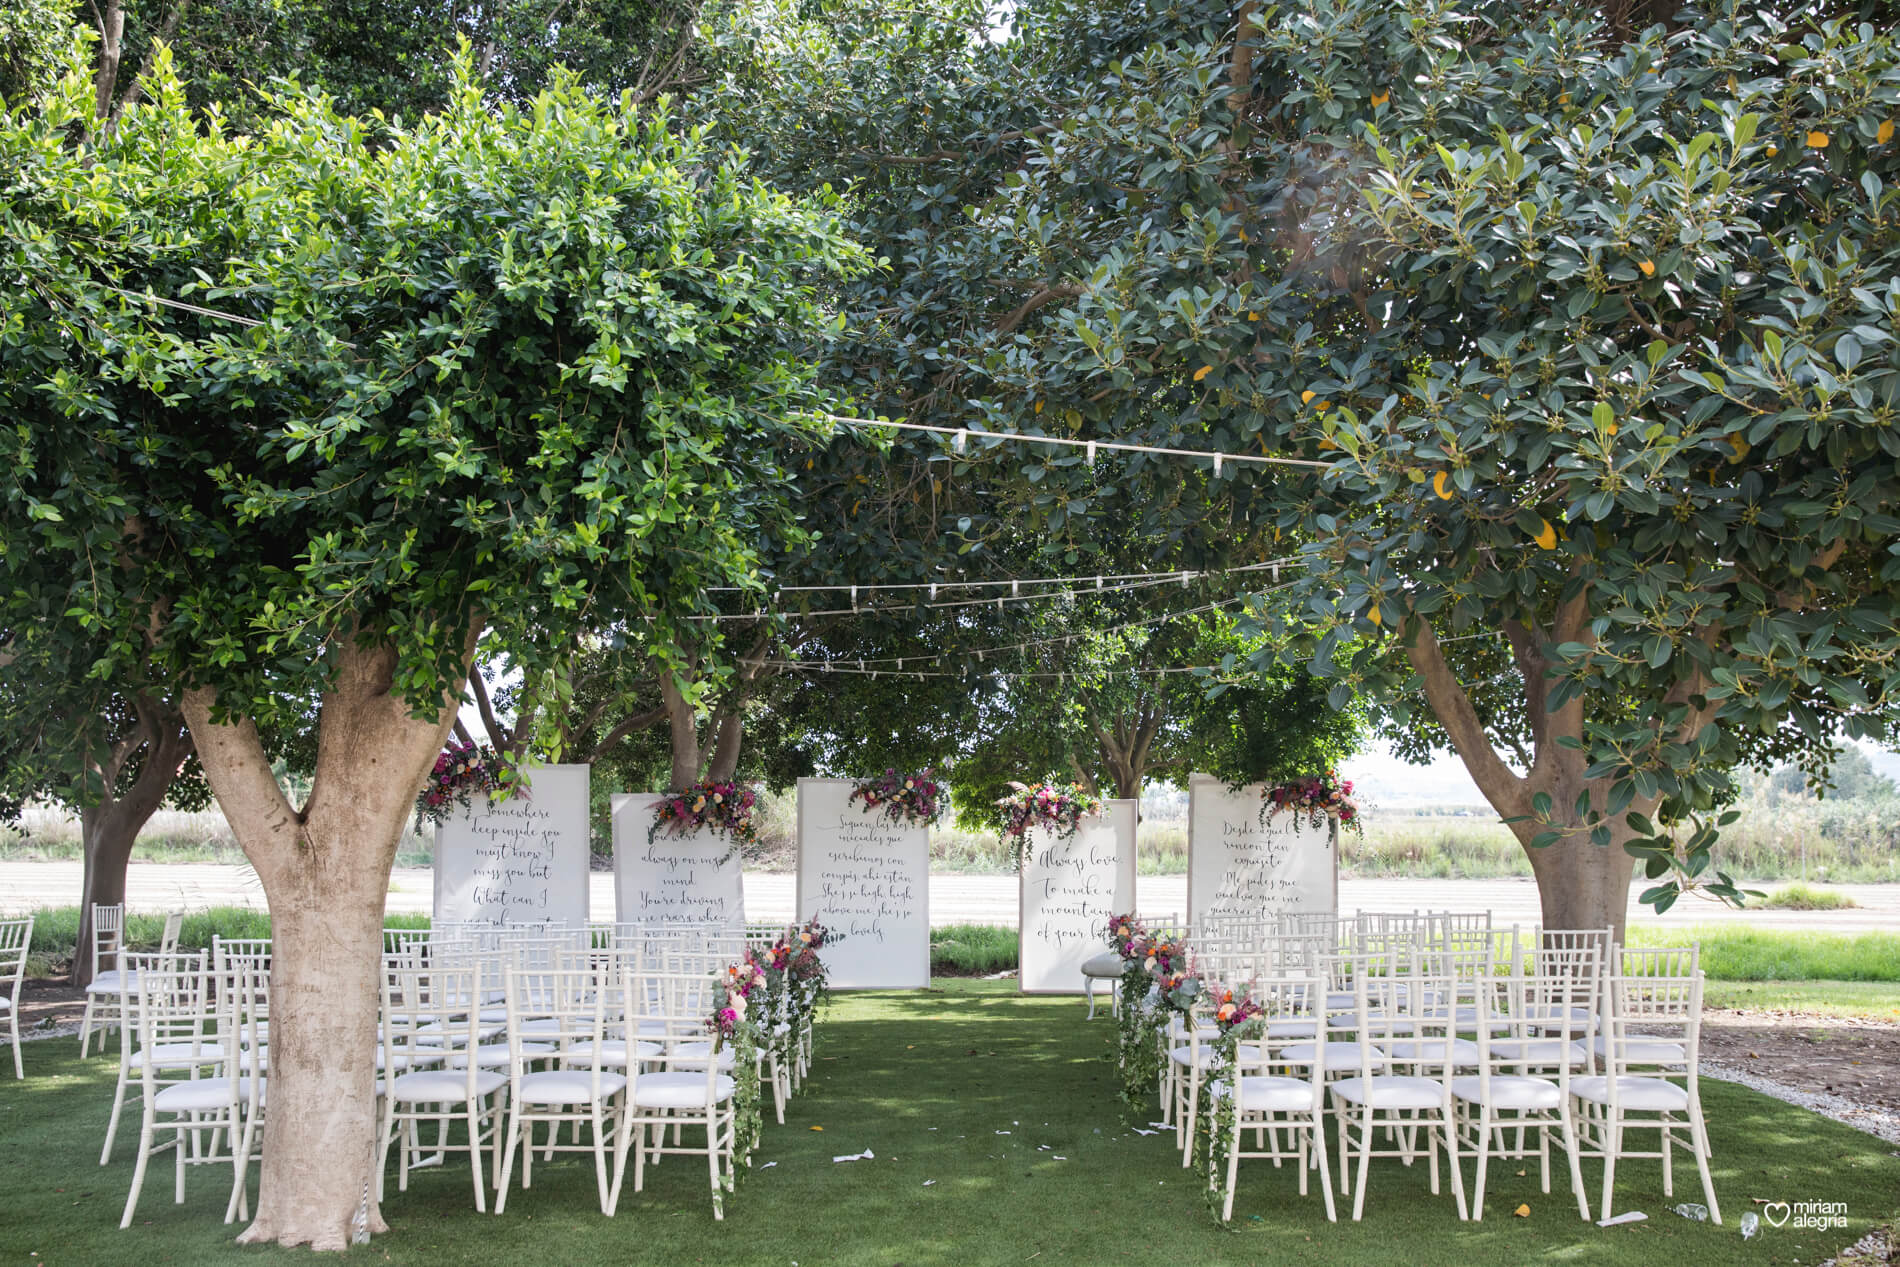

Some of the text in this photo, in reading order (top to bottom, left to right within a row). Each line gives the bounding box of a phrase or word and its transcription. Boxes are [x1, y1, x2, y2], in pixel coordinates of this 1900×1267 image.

[472, 818, 561, 847] deep inside you
[826, 814, 873, 836] Siguen
[1223, 820, 1254, 838] Desde
[476, 843, 508, 860] must
[513, 841, 541, 859] know
[887, 834, 904, 847] que
[1262, 839, 1289, 853] tan
[641, 846, 679, 873] always
[682, 857, 697, 865] on
[828, 844, 906, 865] escribimos con
[1039, 845, 1121, 876] Always love
[1234, 853, 1281, 868] exquisito
[474, 860, 552, 886] miss you but
[663, 871, 696, 886] mind
[1226, 872, 1297, 891] Me pides que
[473, 886, 510, 905] What
[513, 896, 534, 905] can
[849, 889, 858, 900] so
[889, 884, 914, 904] high
[1033, 874, 1116, 899] To make a
[640, 890, 725, 910] You're driving
[822, 898, 852, 915] above
[1259, 895, 1276, 906] que
[1282, 895, 1302, 904] me
[850, 919, 883, 942] lovely
[1037, 922, 1049, 943] of
[1055, 929, 1085, 949] your
